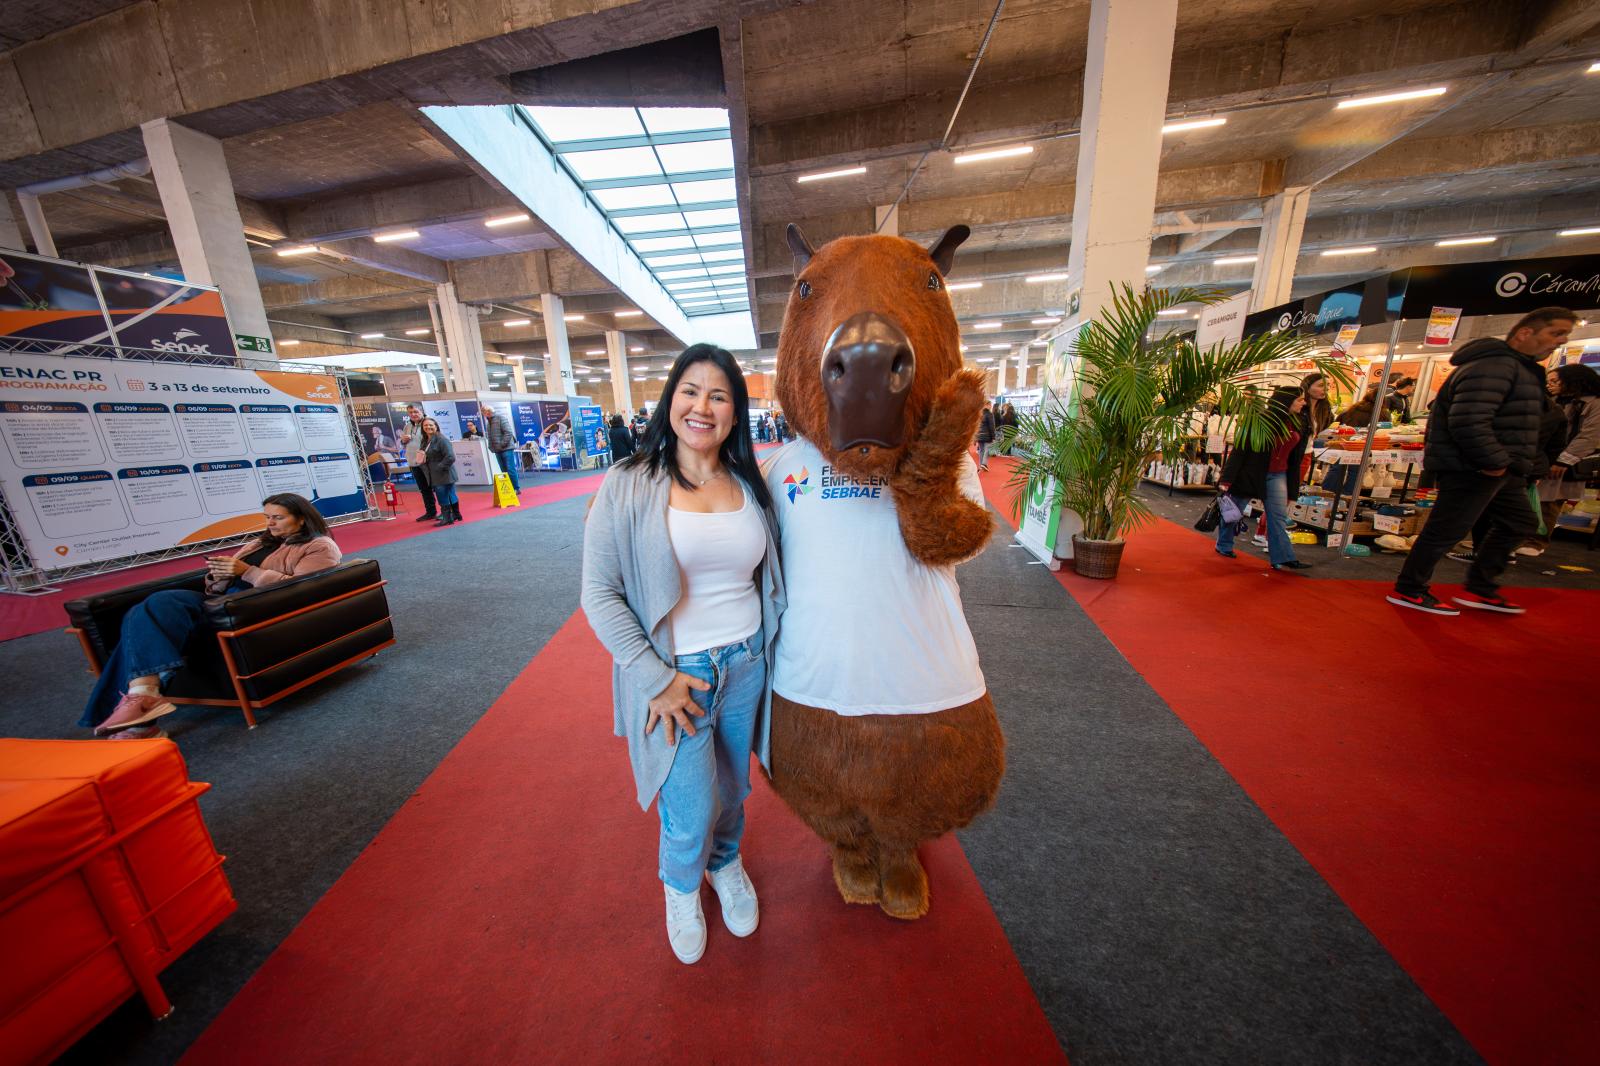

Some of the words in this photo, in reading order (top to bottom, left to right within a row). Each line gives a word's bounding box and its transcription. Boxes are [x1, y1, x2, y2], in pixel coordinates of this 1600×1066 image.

[1207, 312, 1238, 327] CERAMIQUE
[73, 370, 103, 382] PR
[148, 382, 158, 392] 3
[162, 384, 171, 392] a
[173, 383, 188, 392] 13
[191, 384, 209, 393] de
[212, 386, 271, 395] setembro
[50, 475, 79, 483] 09/09
[821, 487, 881, 499] SEBRAE
